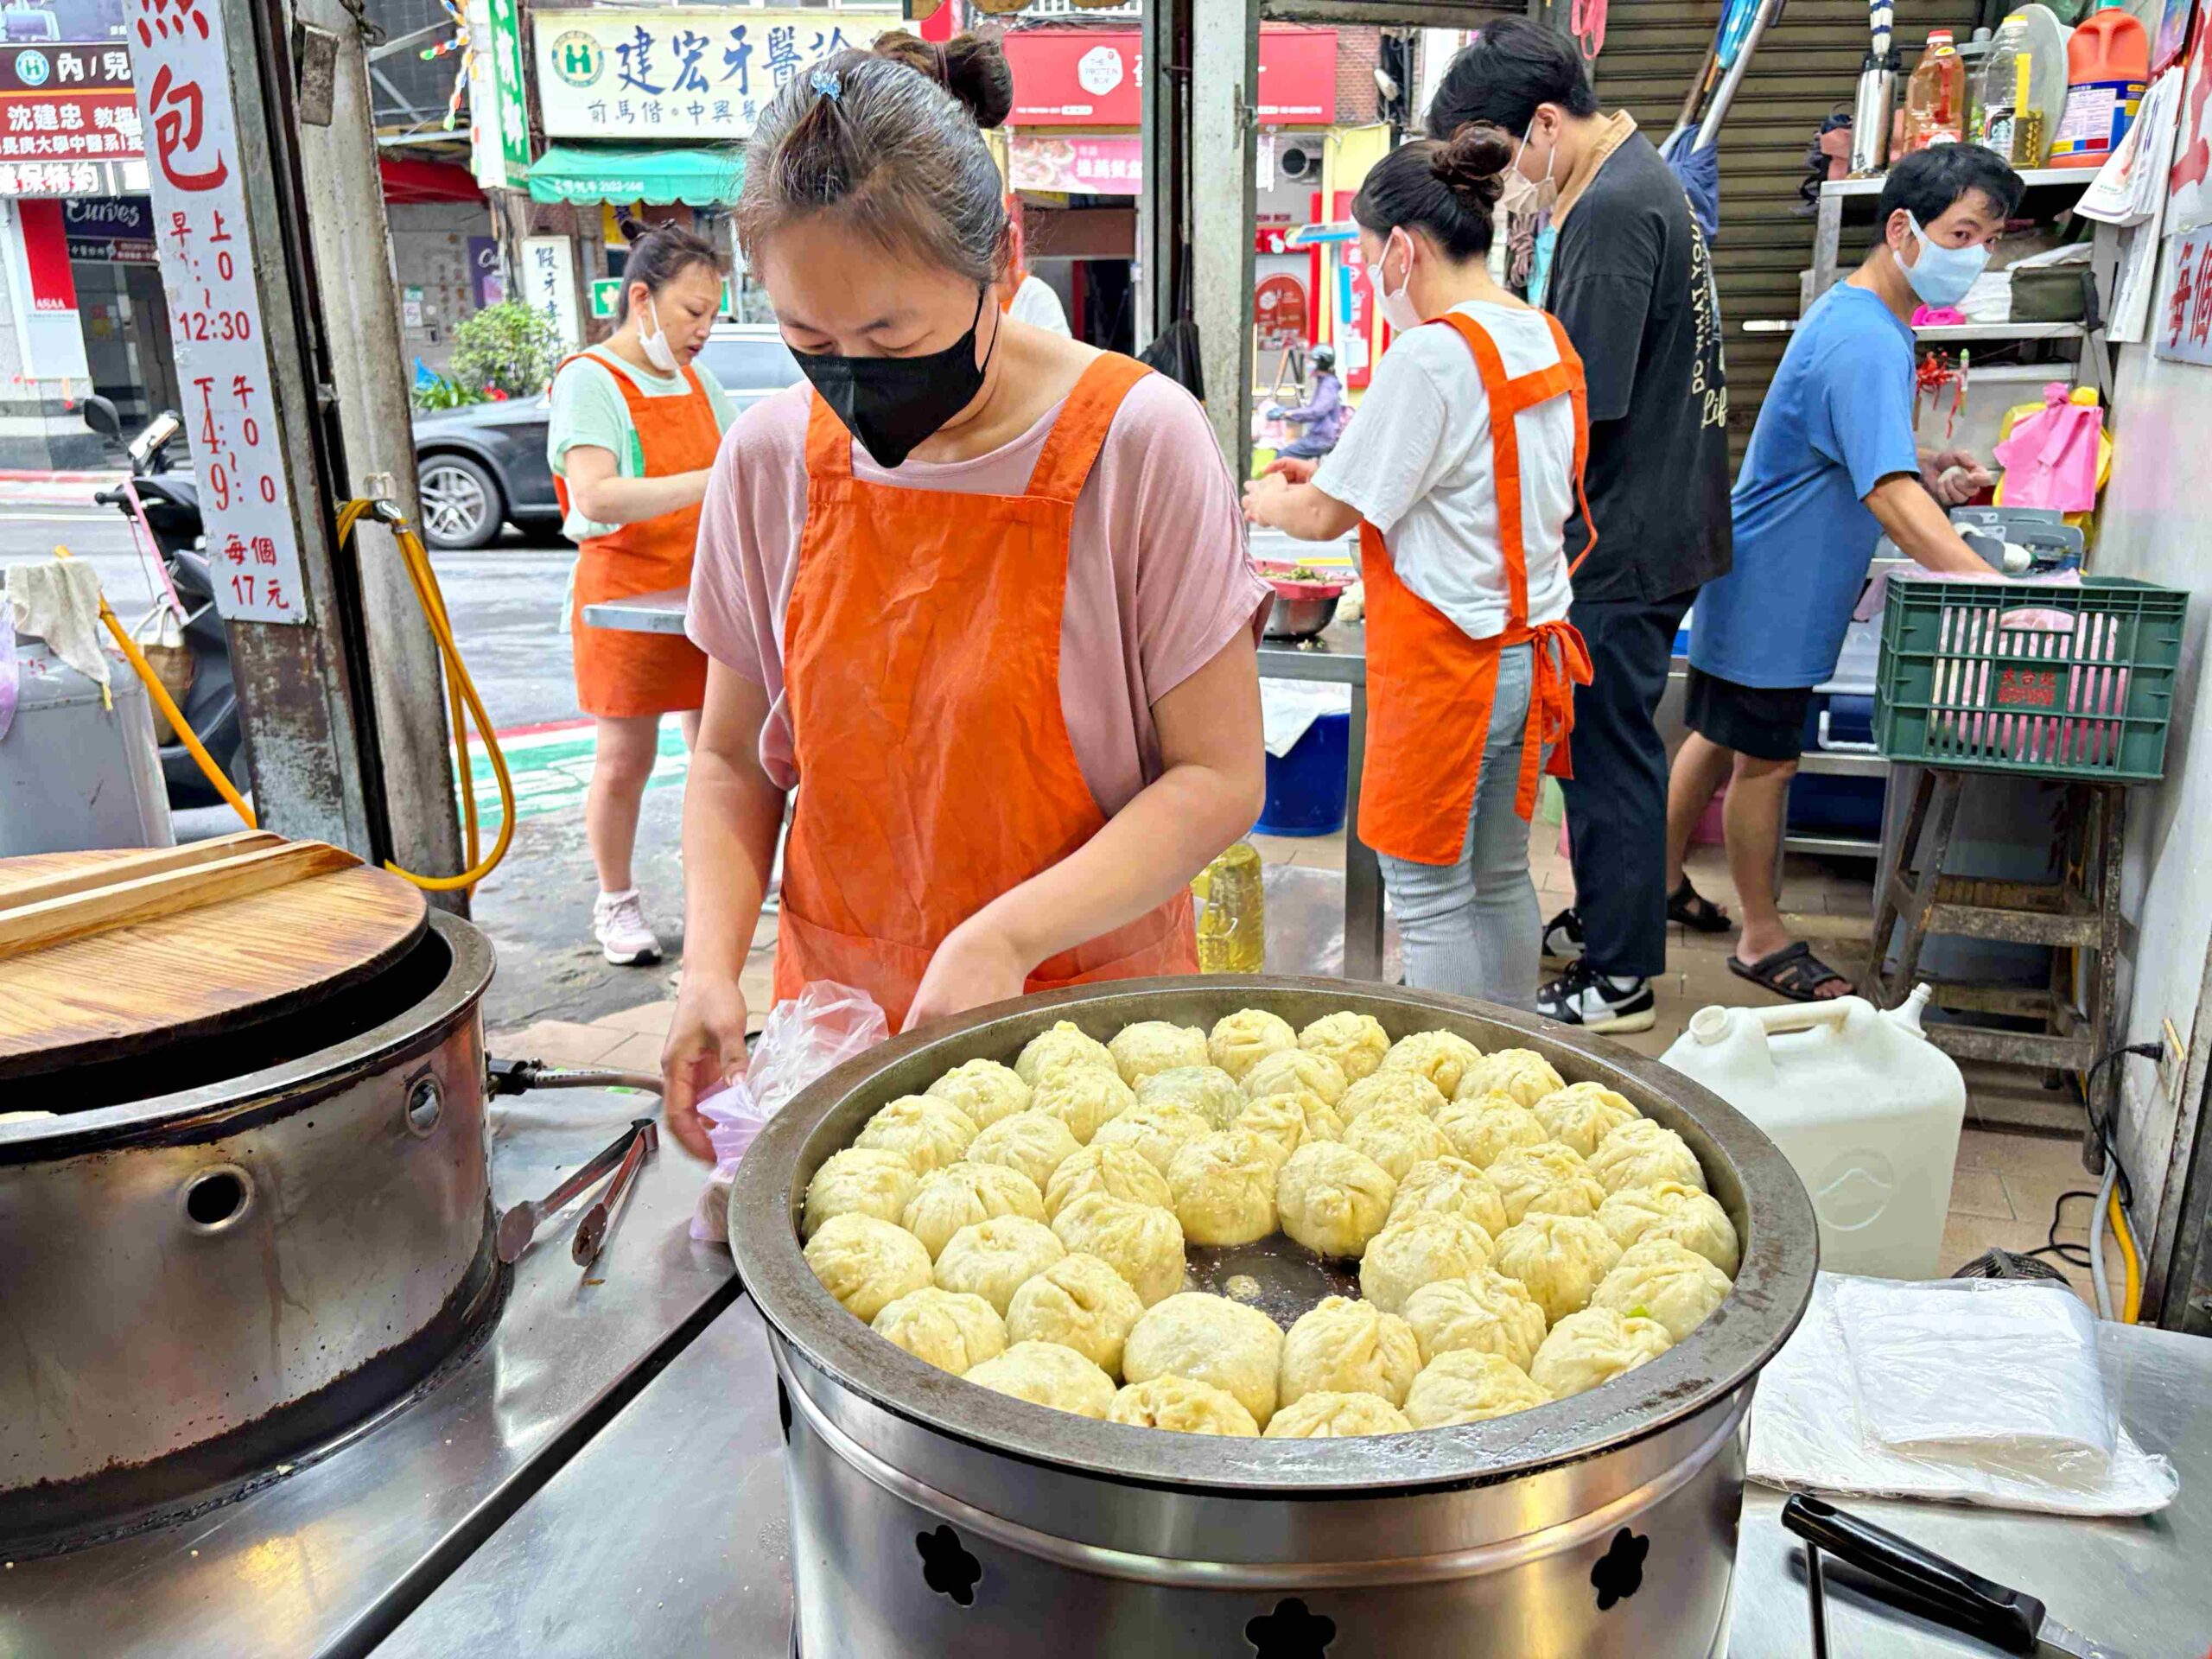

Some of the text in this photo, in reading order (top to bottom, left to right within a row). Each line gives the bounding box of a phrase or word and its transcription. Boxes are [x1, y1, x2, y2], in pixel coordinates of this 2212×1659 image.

[7, 103, 85, 131] 沈建忠
[66, 200, 141, 227] Curves
[170, 210, 232, 247] 早上
[1690, 223, 1703, 281] YOU
[179, 311, 251, 341] 12:30
[194, 374, 255, 410] 下午
[224, 533, 276, 567] 每個
